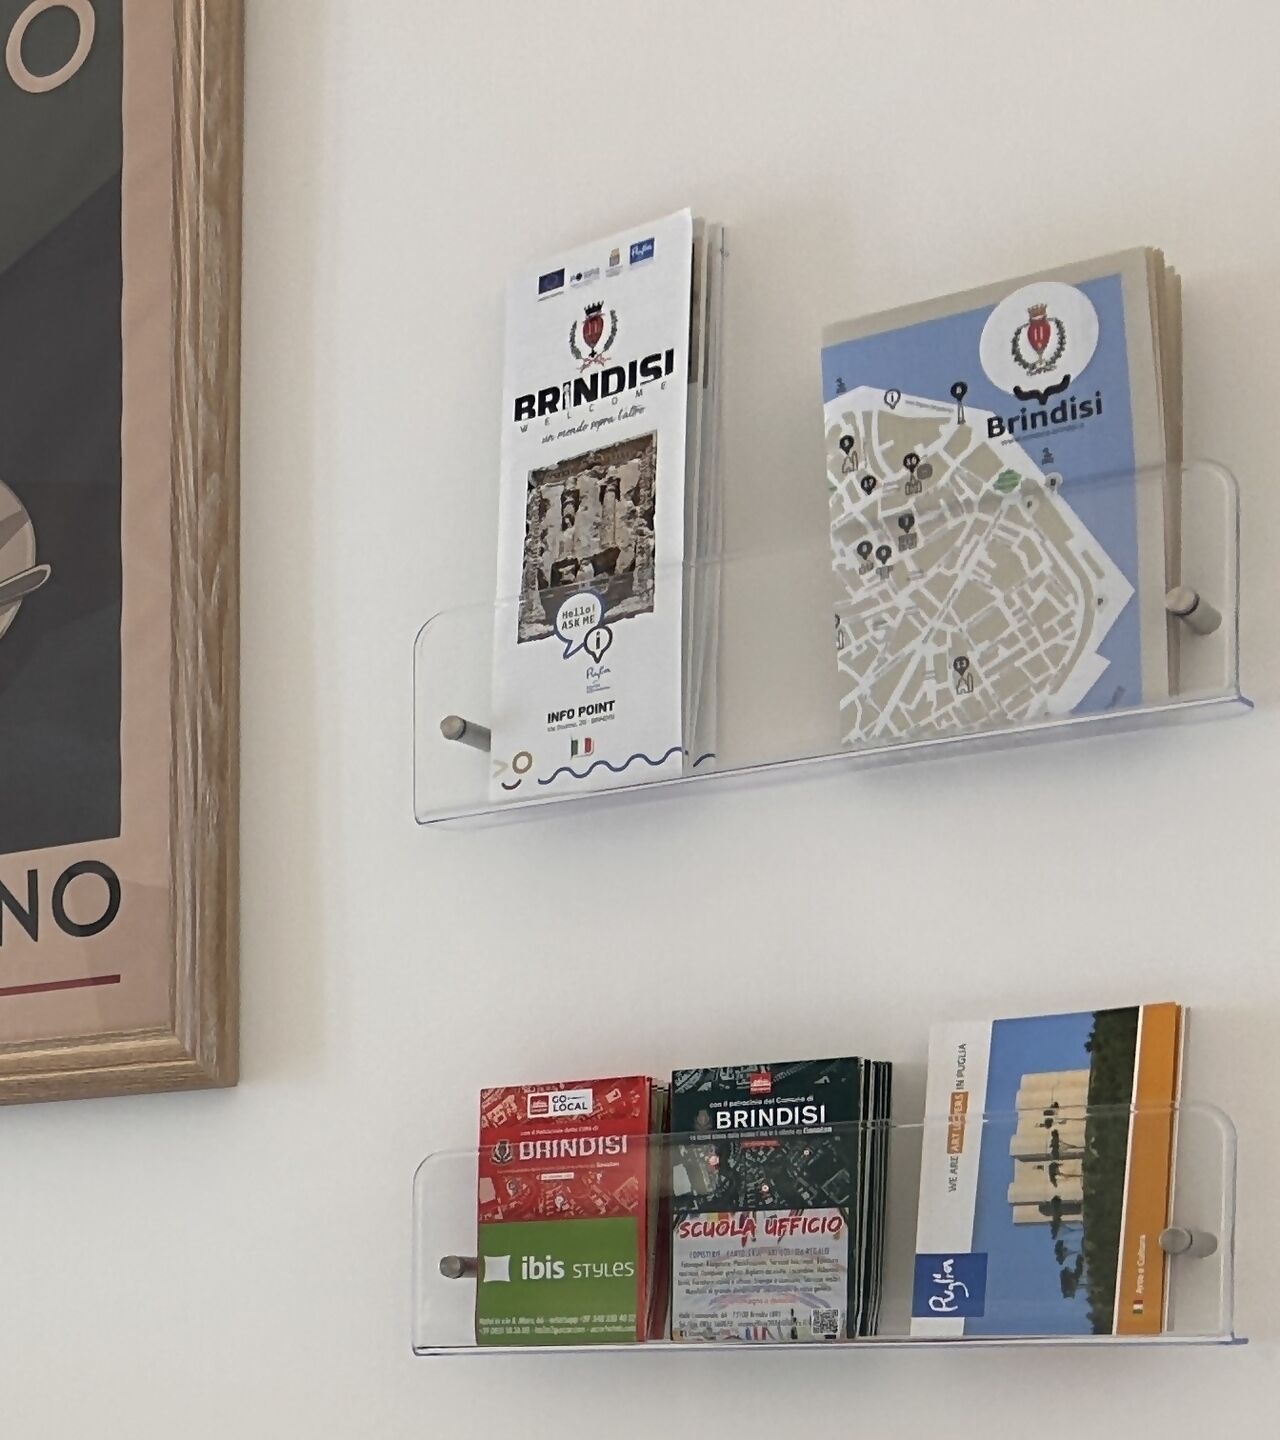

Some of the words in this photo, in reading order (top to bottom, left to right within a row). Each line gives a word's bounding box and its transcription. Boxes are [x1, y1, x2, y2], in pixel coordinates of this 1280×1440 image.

[513, 348, 675, 422] BRINDISI
[987, 390, 1103, 439] Brindisi
[561, 618, 580, 630] ASK
[583, 615, 595, 626] ME
[562, 604, 595, 619] Hello!
[547, 708, 575, 724] INFO
[578, 700, 616, 718] POINT
[957, 1043, 967, 1075] PUGLIA
[552, 1094, 567, 1104] GO
[552, 1101, 588, 1113] LOCAL
[716, 1105, 826, 1130] BRINDISI
[520, 1135, 628, 1161] BRINDISI
[680, 1217, 756, 1239] SCUOLA
[764, 1216, 843, 1238] UFFICIO
[522, 1254, 565, 1280] ibis
